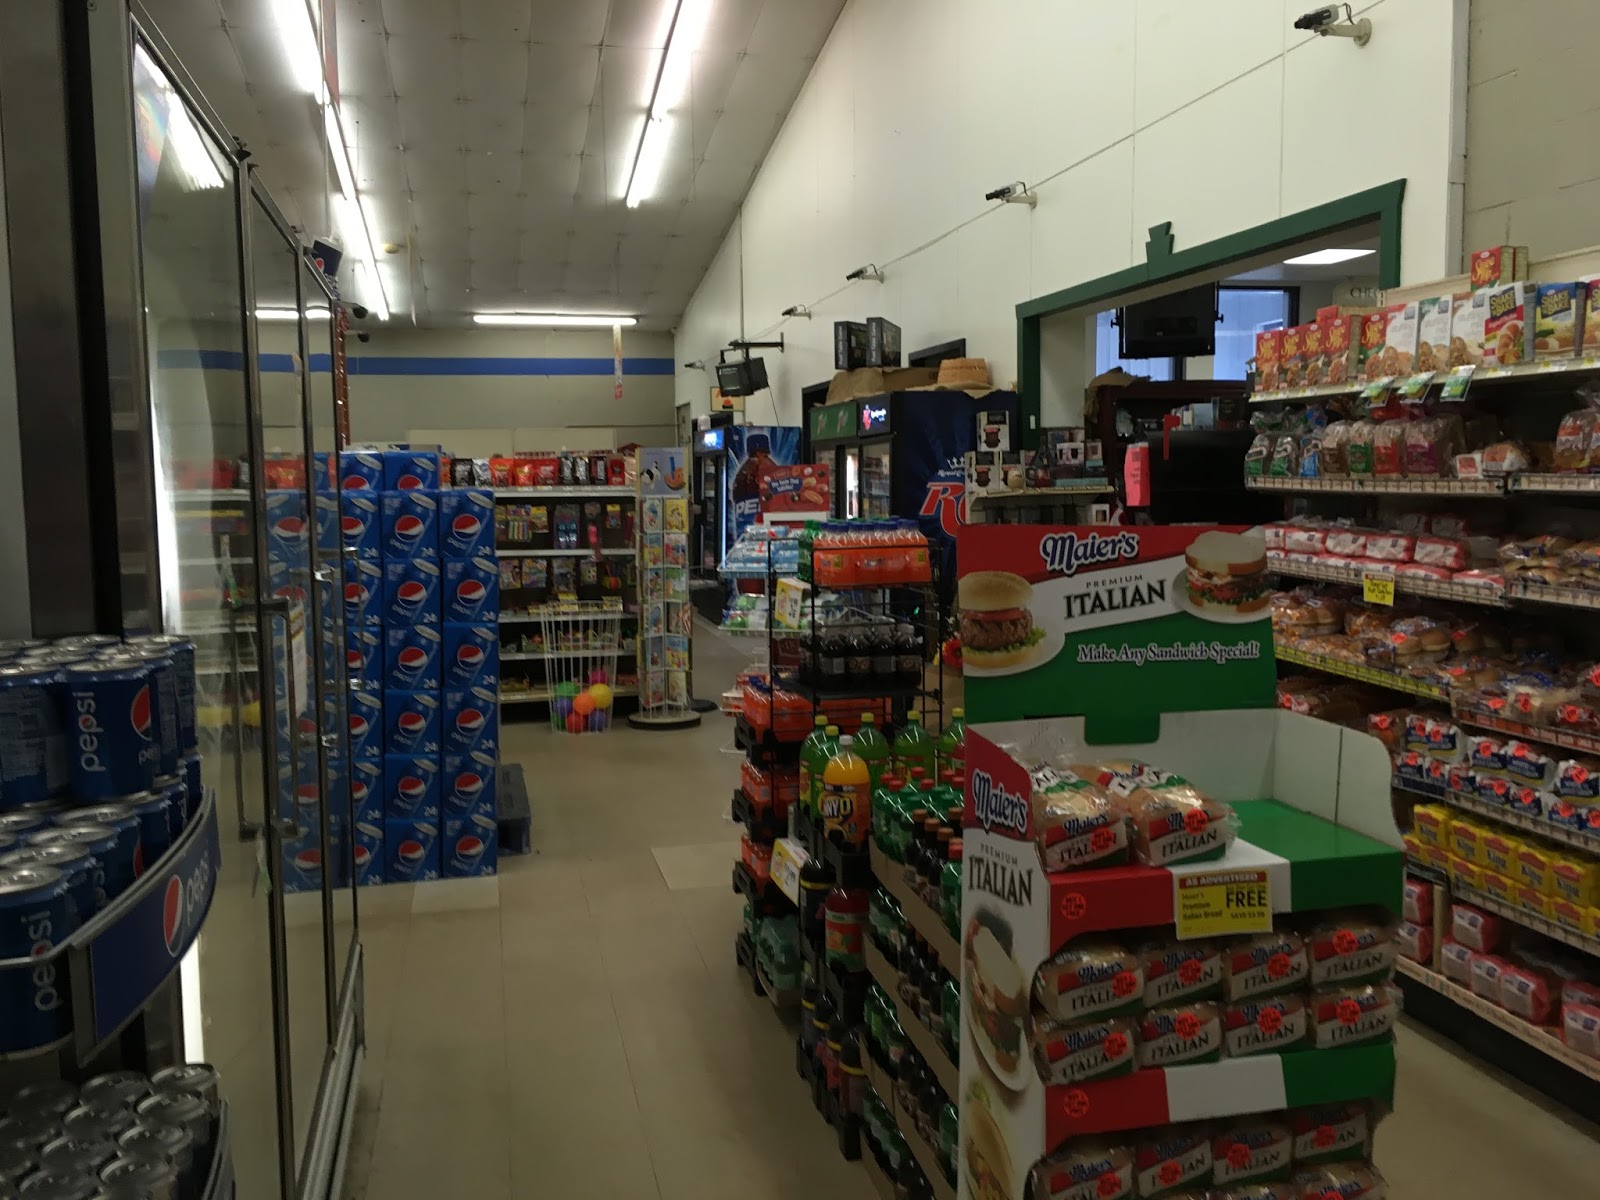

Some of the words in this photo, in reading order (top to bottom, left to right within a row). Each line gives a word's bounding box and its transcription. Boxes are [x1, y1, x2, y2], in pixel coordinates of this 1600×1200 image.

[1040, 531, 1140, 574] Maier's
[1086, 574, 1144, 589] PREMIUM
[1064, 579, 1166, 619] ITALIAN
[1077, 643, 1117, 663] Make
[1117, 642, 1148, 665] Any
[1148, 641, 1208, 662] Sandwich
[1208, 640, 1260, 664] Special!
[72, 691, 106, 772] pepsi
[972, 768, 1028, 834] Maier's
[1064, 814, 1108, 838] Maier's
[980, 844, 1018, 867] PREMIUM
[1162, 828, 1217, 857] ITALIAN
[967, 853, 1034, 907] ITALIAN
[1226, 889, 1268, 909] FREE
[21, 910, 64, 1011] pepsi
[1062, 1052, 1110, 1077] ITALIA
